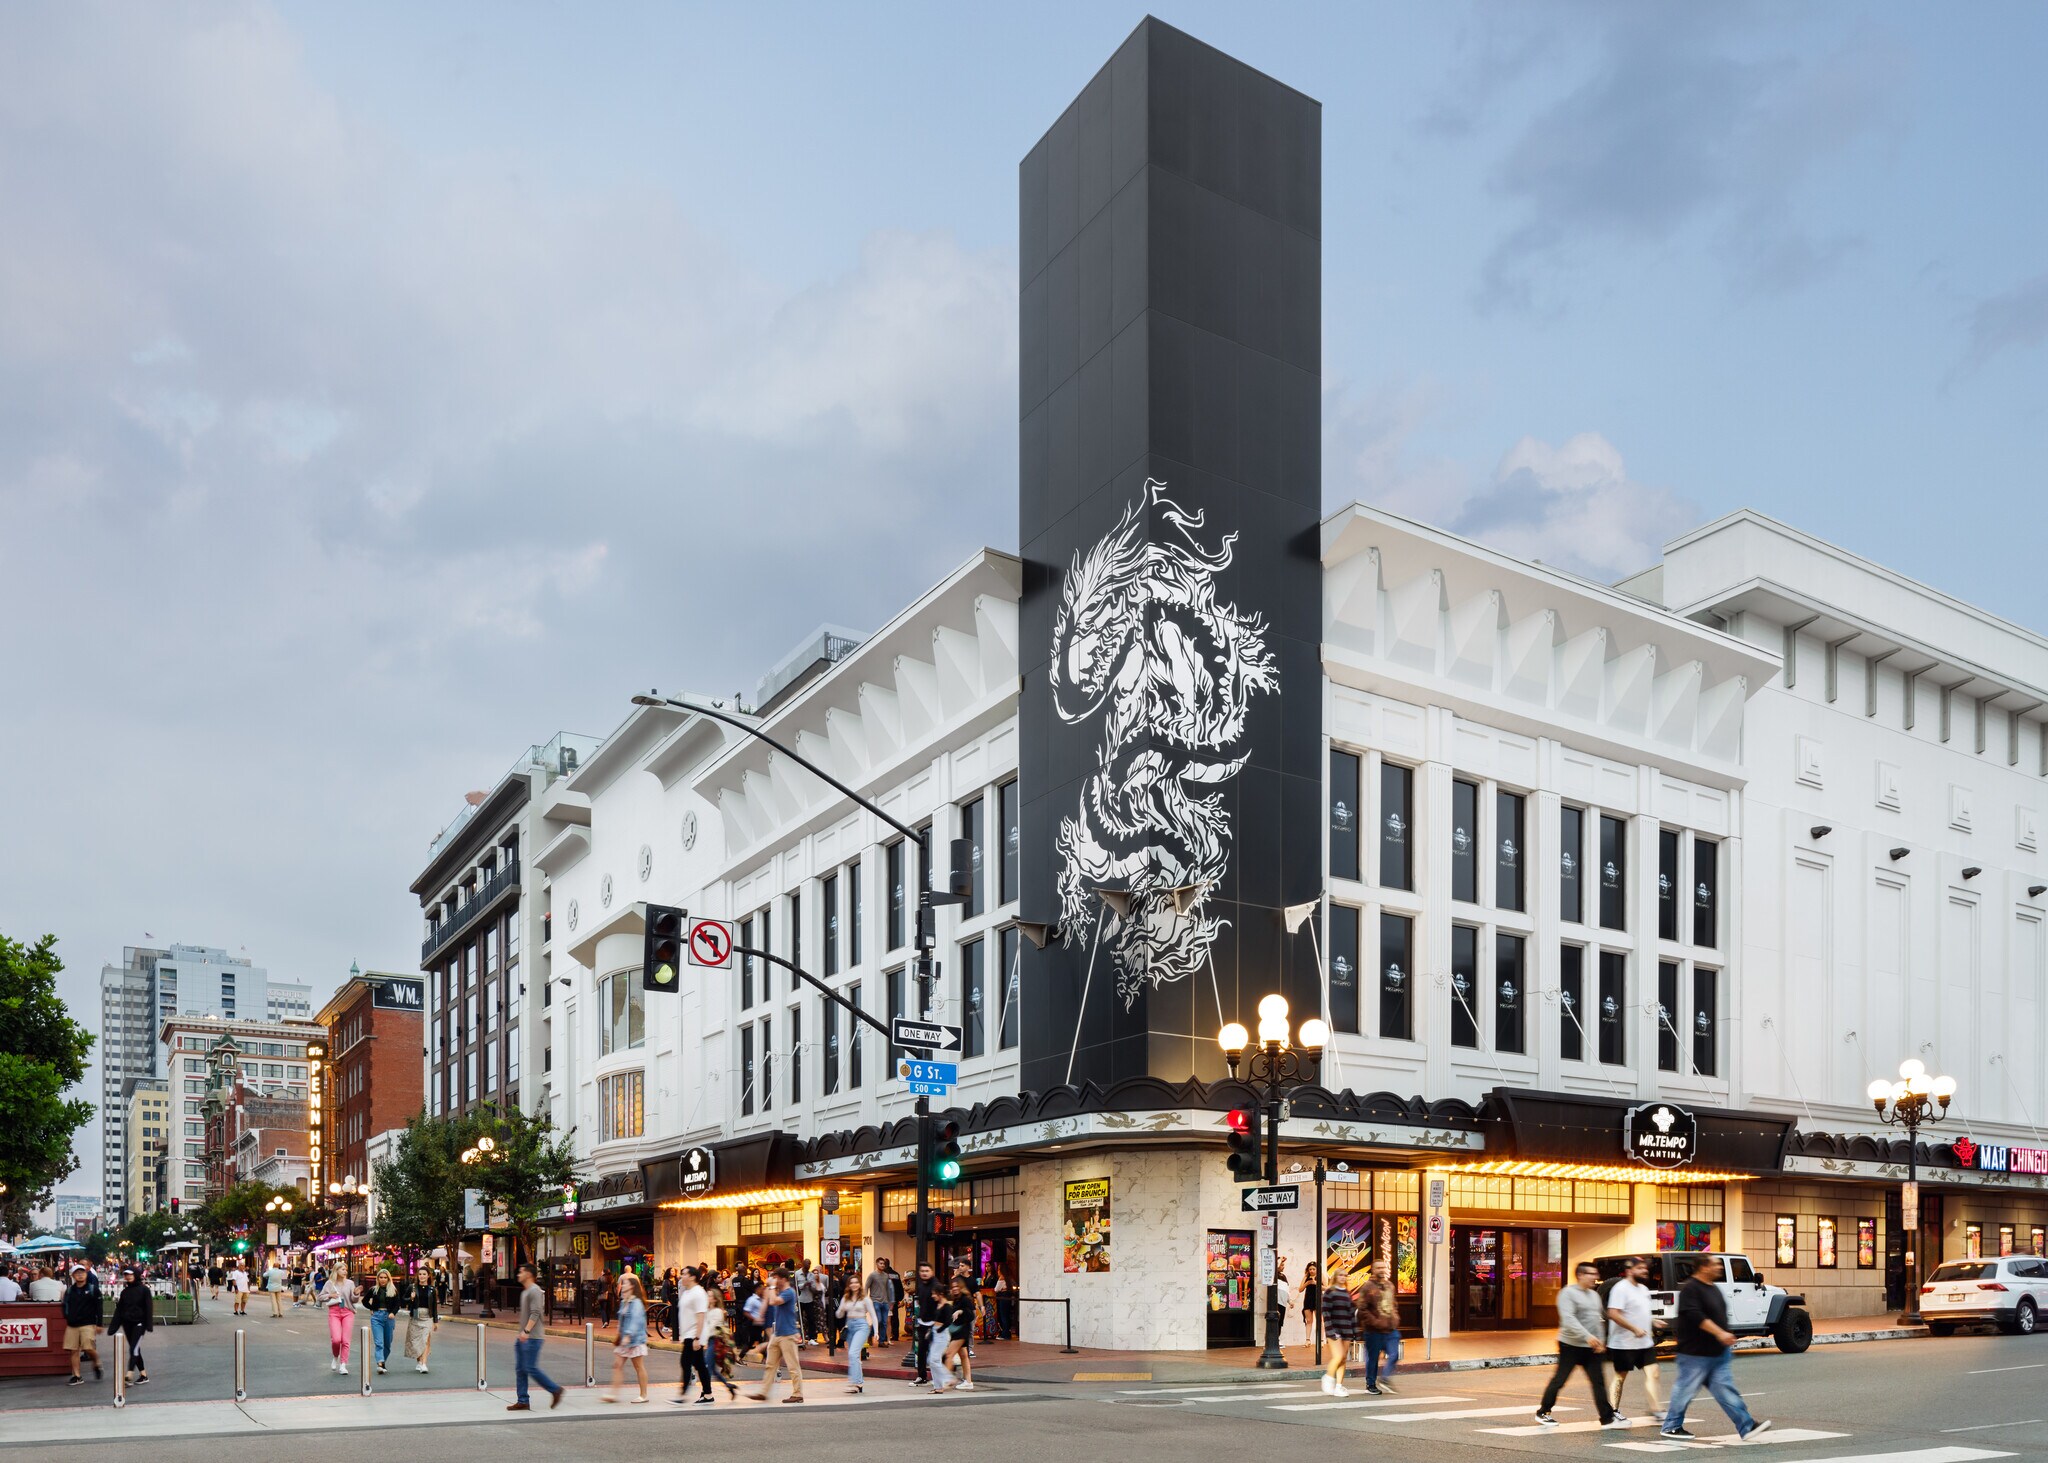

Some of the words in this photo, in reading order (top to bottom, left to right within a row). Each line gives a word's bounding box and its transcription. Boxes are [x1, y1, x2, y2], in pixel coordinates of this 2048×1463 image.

[903, 1028, 921, 1039] ONE
[923, 1031, 941, 1041] WAY
[913, 1065, 922, 1078] G
[310, 1060, 321, 1125] PENN
[914, 1085, 929, 1093] 500
[1643, 1149, 1682, 1159] CANTINA
[1980, 1144, 2007, 1171] MAR
[1285, 1174, 1302, 1183] FIFTH
[686, 1183, 705, 1191] CANTINA
[1073, 1183, 1086, 1191] NOW
[1086, 1182, 1102, 1190] OPEN
[1068, 1191, 1080, 1199] FOR
[1081, 1189, 1106, 1198] BRUNCH
[1257, 1193, 1273, 1204] ONE
[1275, 1192, 1294, 1203] WAY
[863, 1236, 872, 1245] 701
[1207, 1234, 1226, 1244] HAPPY
[0, 1324, 43, 1341] SKEY
